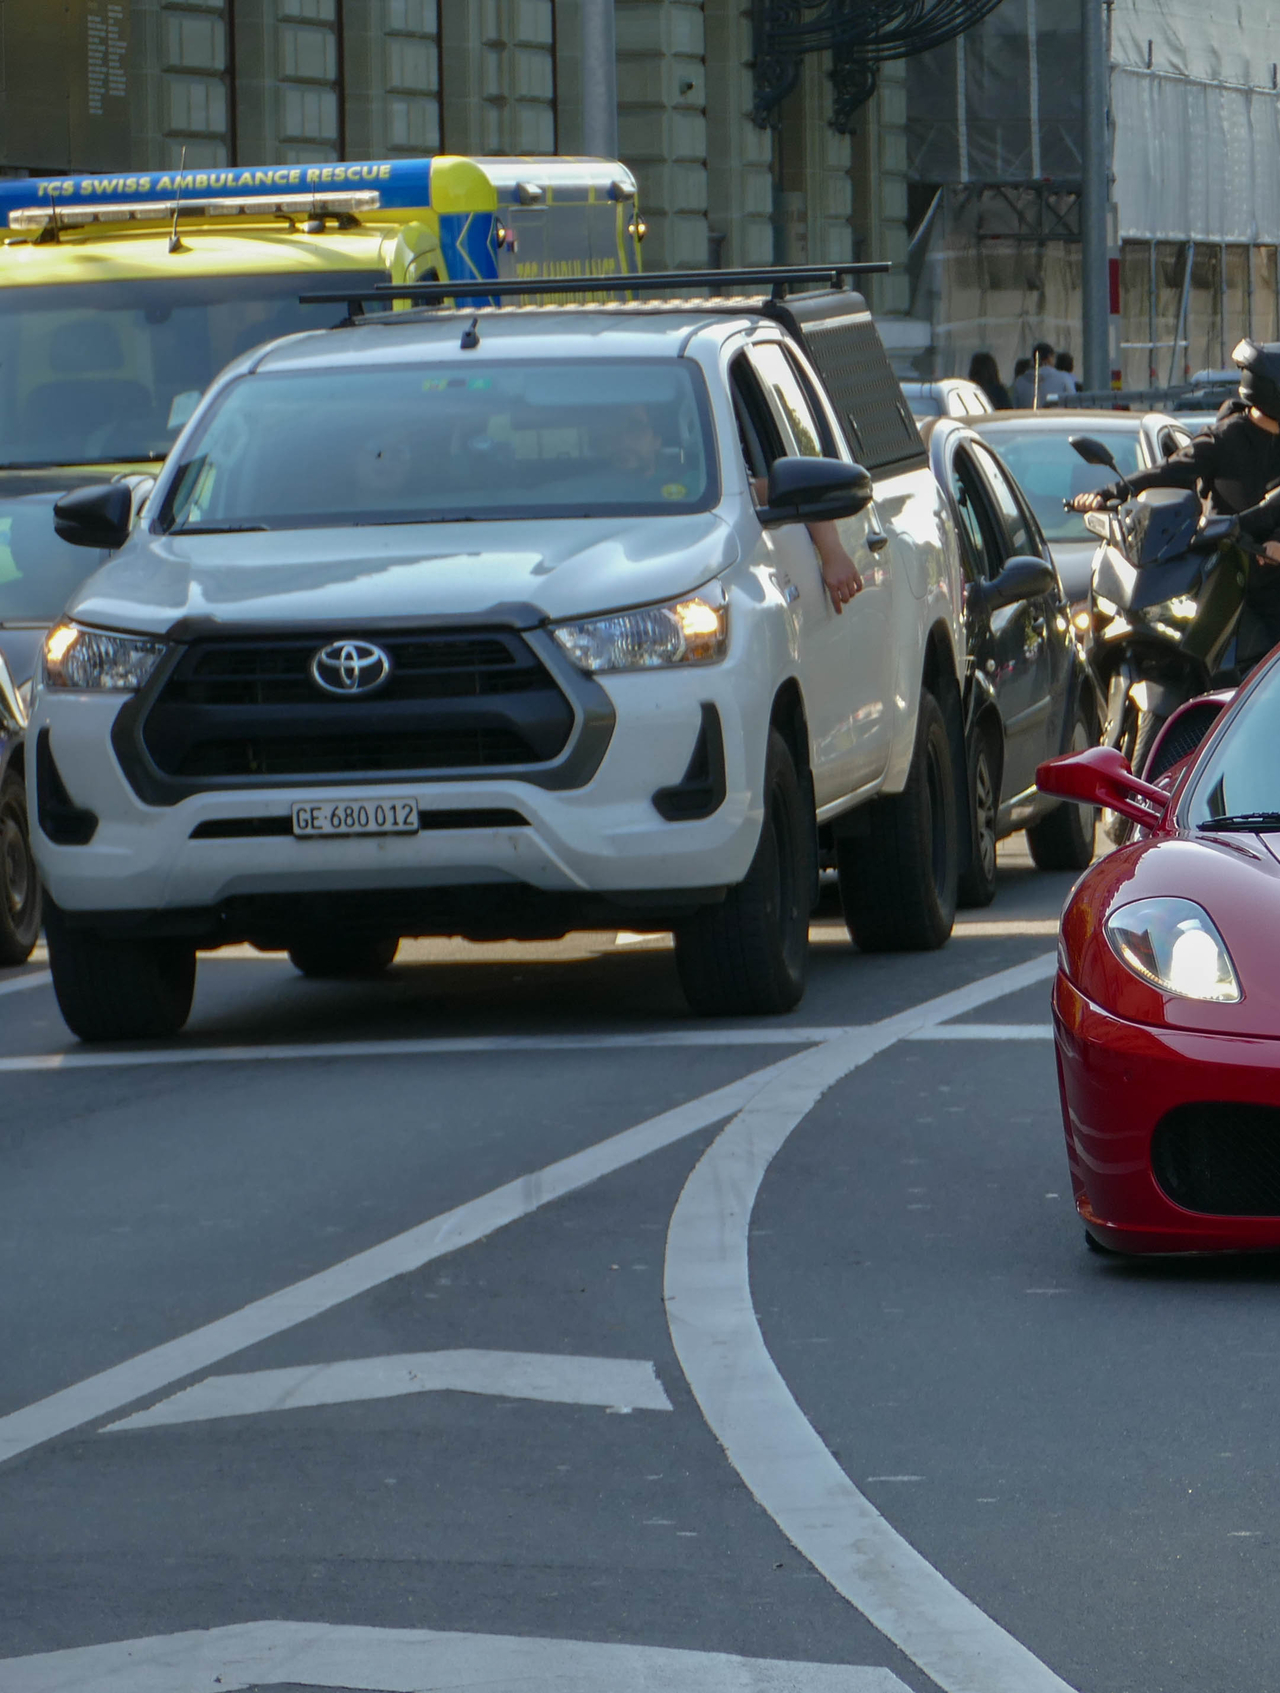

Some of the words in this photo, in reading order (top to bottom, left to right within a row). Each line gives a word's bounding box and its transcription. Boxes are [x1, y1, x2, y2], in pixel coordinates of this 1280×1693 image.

[37, 181, 74, 197] TCS
[80, 178, 151, 195] SWISS
[155, 170, 301, 191] AMBULANCE
[306, 165, 392, 183] RESCUE
[375, 803, 414, 827] 012
